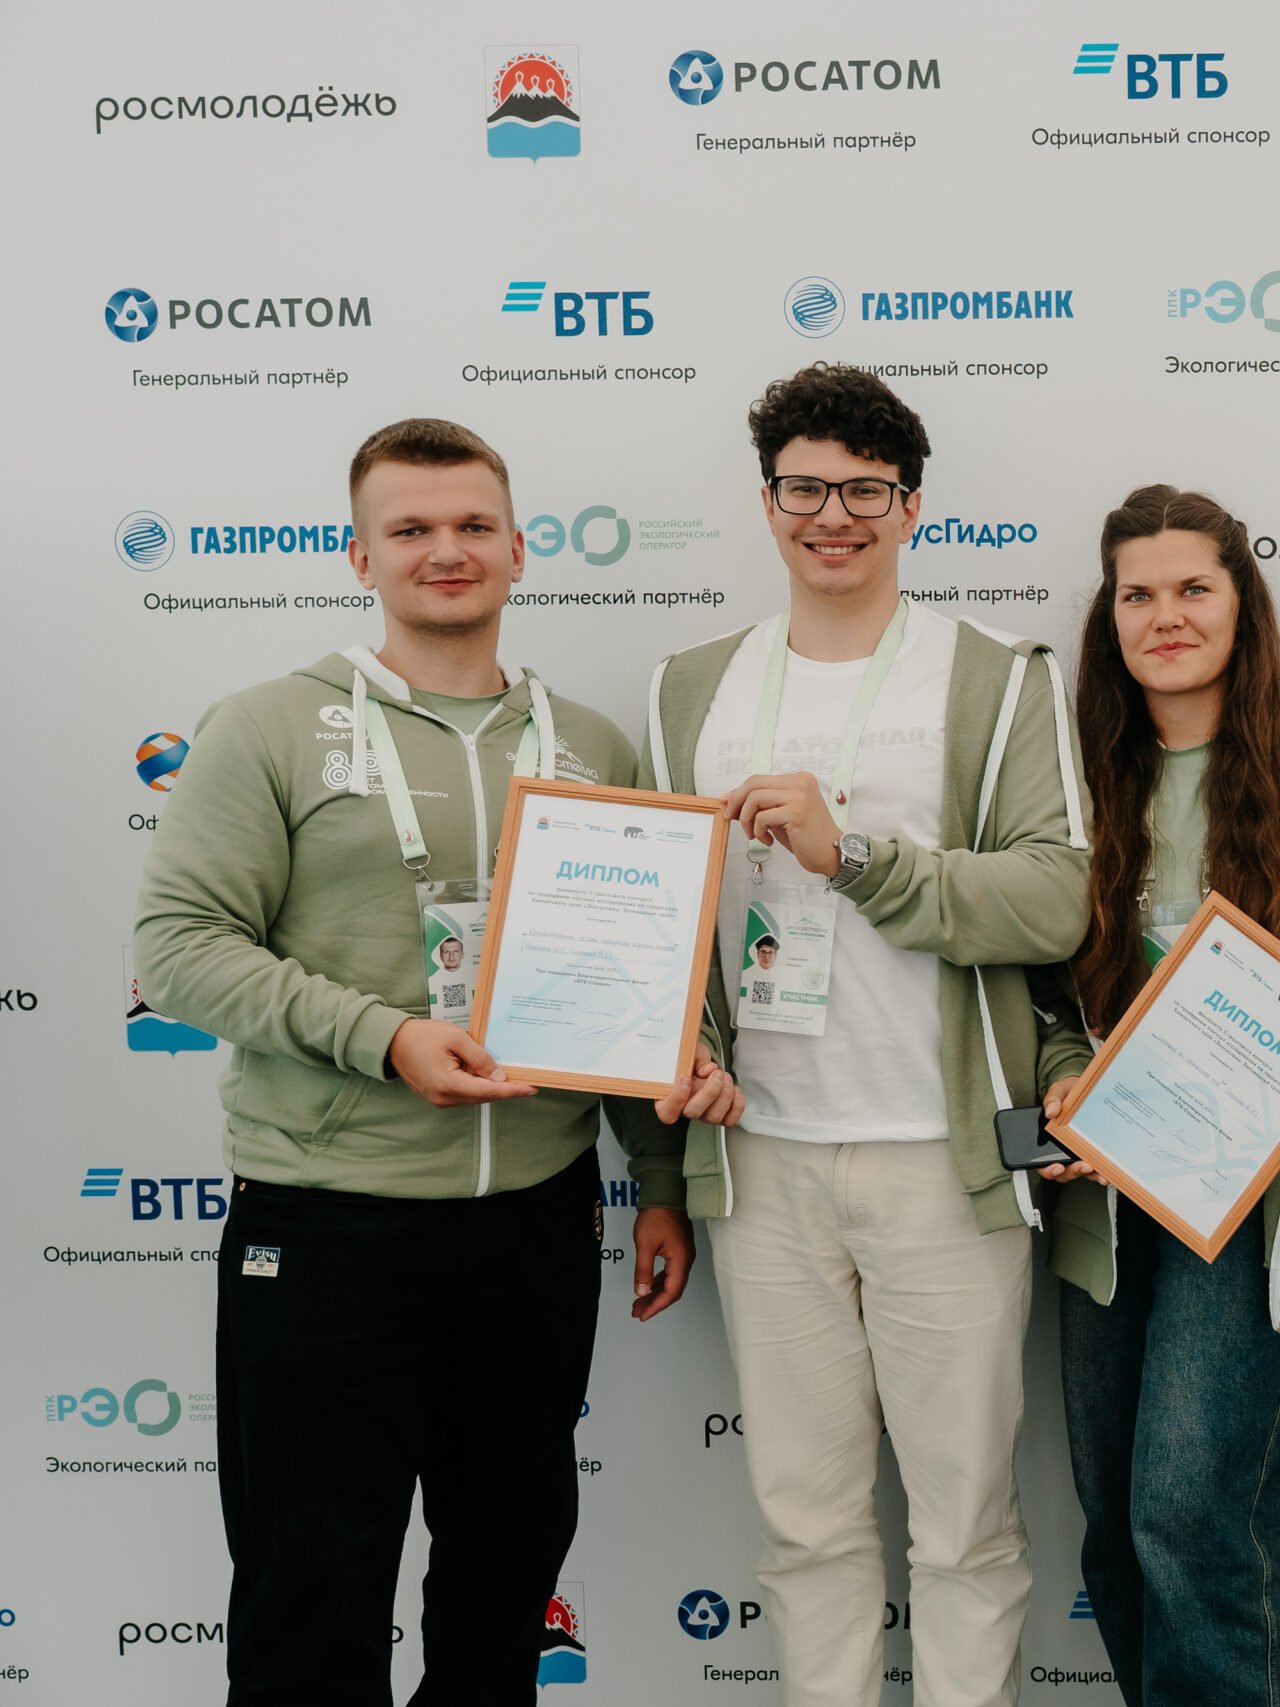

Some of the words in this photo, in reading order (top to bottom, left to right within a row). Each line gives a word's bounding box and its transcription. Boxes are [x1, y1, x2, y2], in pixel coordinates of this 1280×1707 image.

[735, 59, 940, 92] РОСАТОМ
[1127, 53, 1228, 99] ВТБ
[96, 86, 396, 134] росмолодёжь
[697, 133, 824, 154] Генеральный
[834, 132, 916, 152] партнёр
[1032, 128, 1179, 149] Официальный
[1187, 131, 1270, 146] спонсор
[169, 297, 371, 329] РОСАТОМ
[554, 291, 653, 336] ВТБ
[862, 290, 1074, 320] ГАЗПРОМБАНК
[133, 370, 259, 390] Генеральный
[267, 369, 348, 388] партнёр
[462, 365, 606, 385] Официальный
[615, 368, 696, 383] спонсор
[812, 360, 959, 382] Оциальный
[965, 361, 1049, 380] спонсор
[639, 519, 703, 529] РОССИЙСКИЙ
[911, 518, 1038, 550] усГидро
[191, 524, 354, 554] ГАЗПРОМБА
[639, 530, 720, 541] ЭКОЛОГИЧЕСКИЙ
[639, 541, 687, 551] ОПЕРАТОР
[144, 593, 286, 613] Официальный
[295, 596, 374, 611] спонсор
[504, 588, 636, 607] кологический
[642, 586, 725, 608] партнёр
[966, 584, 1049, 605] партнёр
[556, 860, 660, 888] ДИПЛОМ
[131, 1178, 229, 1221] ВТБ
[44, 1246, 183, 1266] Официальный
[247, 1247, 277, 1262] Evisu
[46, 1457, 188, 1473] Экологический
[704, 1665, 780, 1684] Генерал
[1030, 1666, 1117, 1687] Официа
